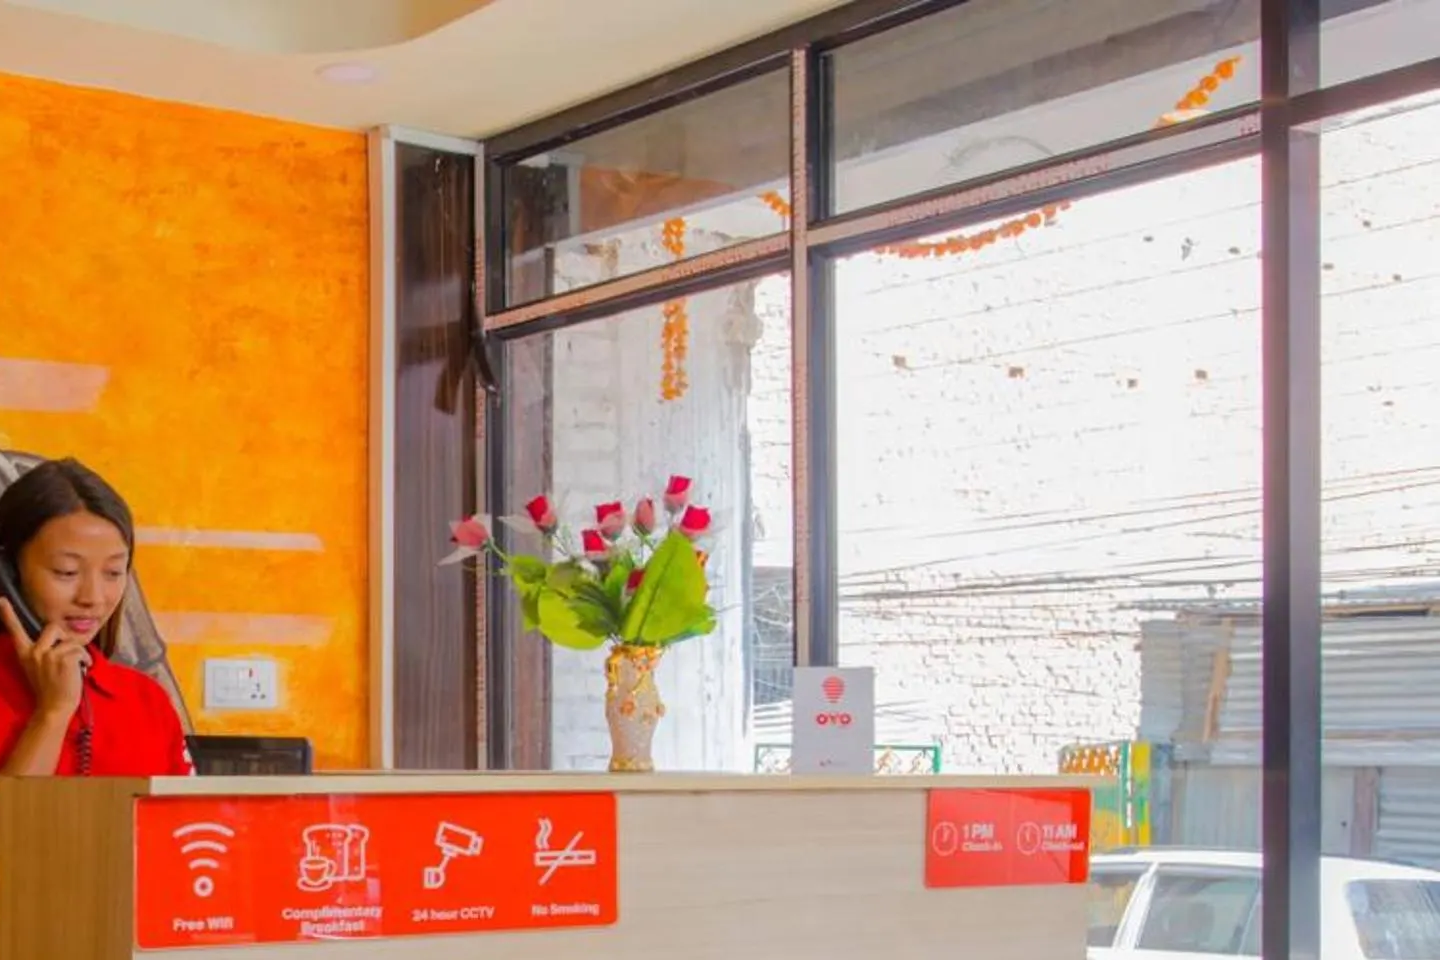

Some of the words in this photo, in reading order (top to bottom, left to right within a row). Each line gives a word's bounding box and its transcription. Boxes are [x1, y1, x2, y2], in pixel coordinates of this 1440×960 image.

[816, 713, 852, 725] OYO
[962, 823, 970, 838] 1
[972, 823, 994, 838] PM
[1055, 824, 1077, 838] AM
[281, 905, 383, 921] Complimentary
[412, 908, 428, 921] 24
[430, 907, 458, 921] hour
[460, 906, 495, 919] CCTV
[531, 903, 548, 916] No
[549, 902, 600, 917] Smoking
[173, 917, 205, 932] Free
[300, 919, 365, 935] Breakfast
